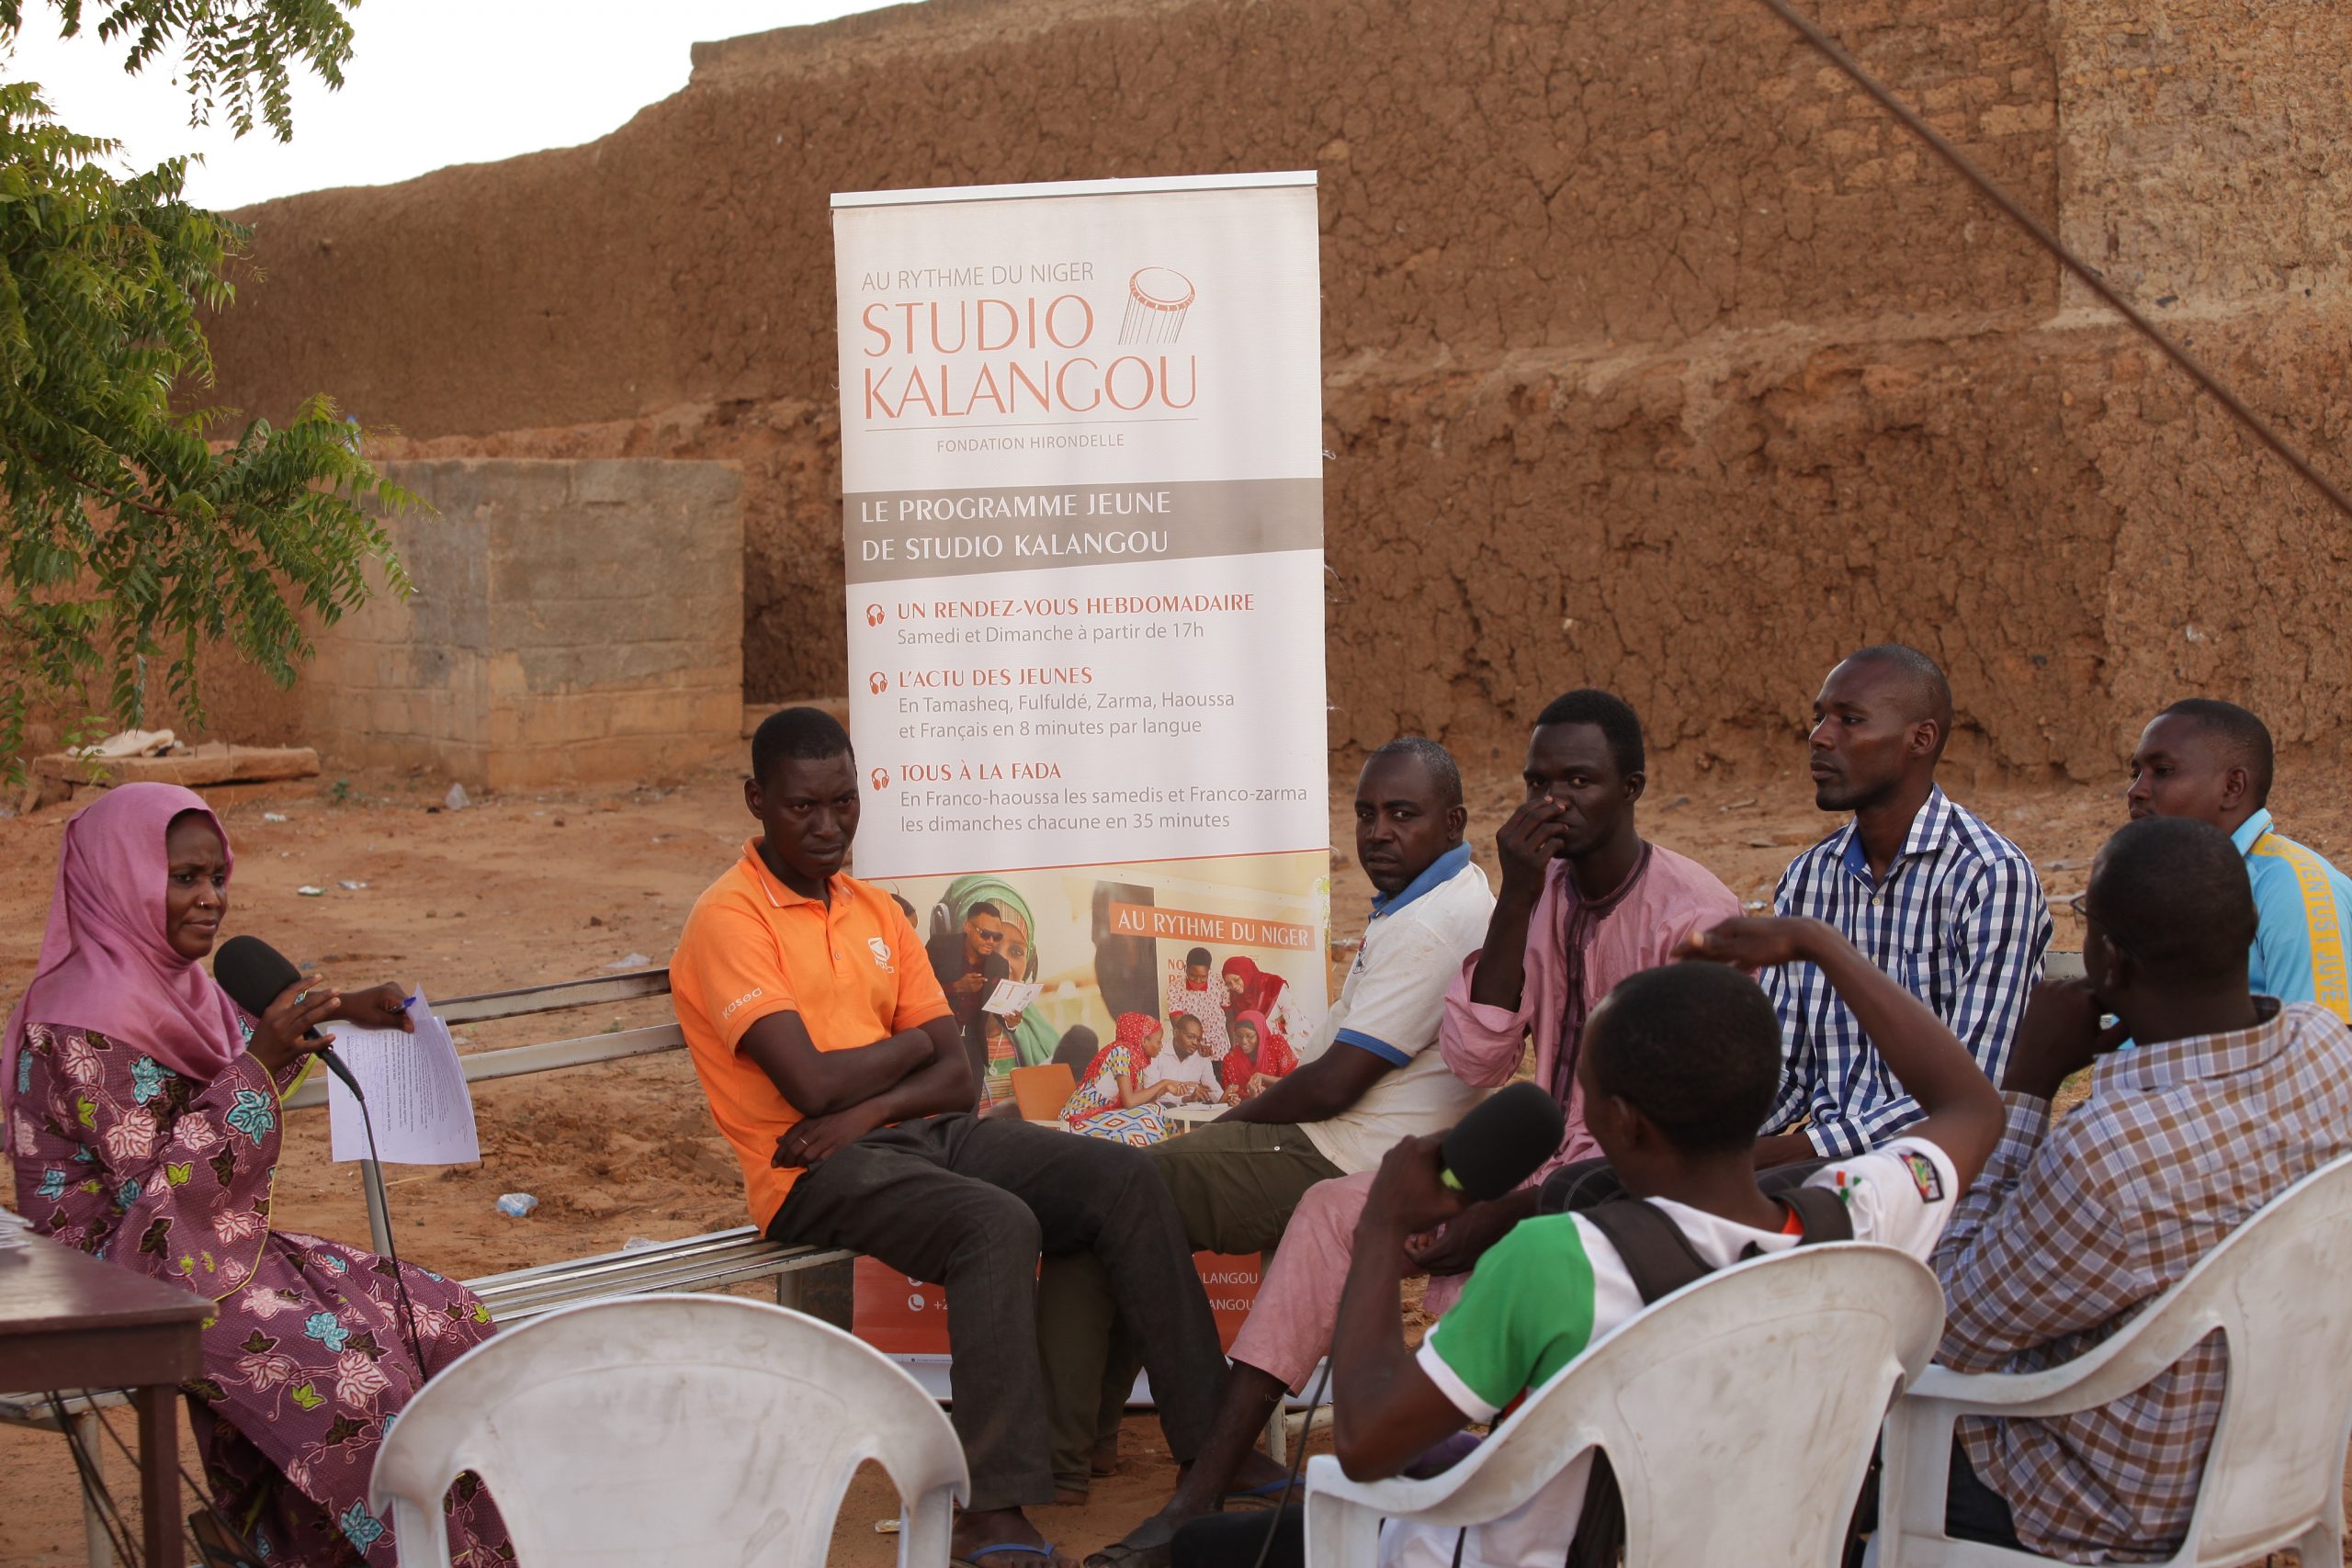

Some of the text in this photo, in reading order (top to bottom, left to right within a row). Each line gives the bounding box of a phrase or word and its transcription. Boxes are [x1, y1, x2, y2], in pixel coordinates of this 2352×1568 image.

[862, 262, 1093, 290] AU RYTHME DU NIGER
[862, 294, 1093, 357] STUDIO
[865, 355, 1196, 419] KALANGOU
[937, 434, 1124, 452] FONDATION HIRONDELLE
[862, 491, 1170, 523] LE PROGRAMME JEUNE
[863, 530, 1169, 561] DE STUDIO KALANGOU
[898, 593, 1255, 619] UN RENDEZ-VOUS HEBDOMADAIRE
[898, 622, 1204, 645] Samedi et Dimanche à partir de 17h
[899, 667, 1092, 688] L'ACTU DES JEUNES
[899, 692, 1235, 716] En Tamasheq, Fulfuldé, Zarma, Haoussa
[899, 718, 1202, 742] et Français en 8 minutes par langue
[900, 760, 1061, 782] TOUS À LA FADA
[901, 786, 1307, 807] En Franco-haoussa les samedis et Franco-zarma
[901, 812, 1229, 832] les dimanches chacune en 35 minutes
[1118, 909, 1307, 946] AU RYTHME DU NIGER
